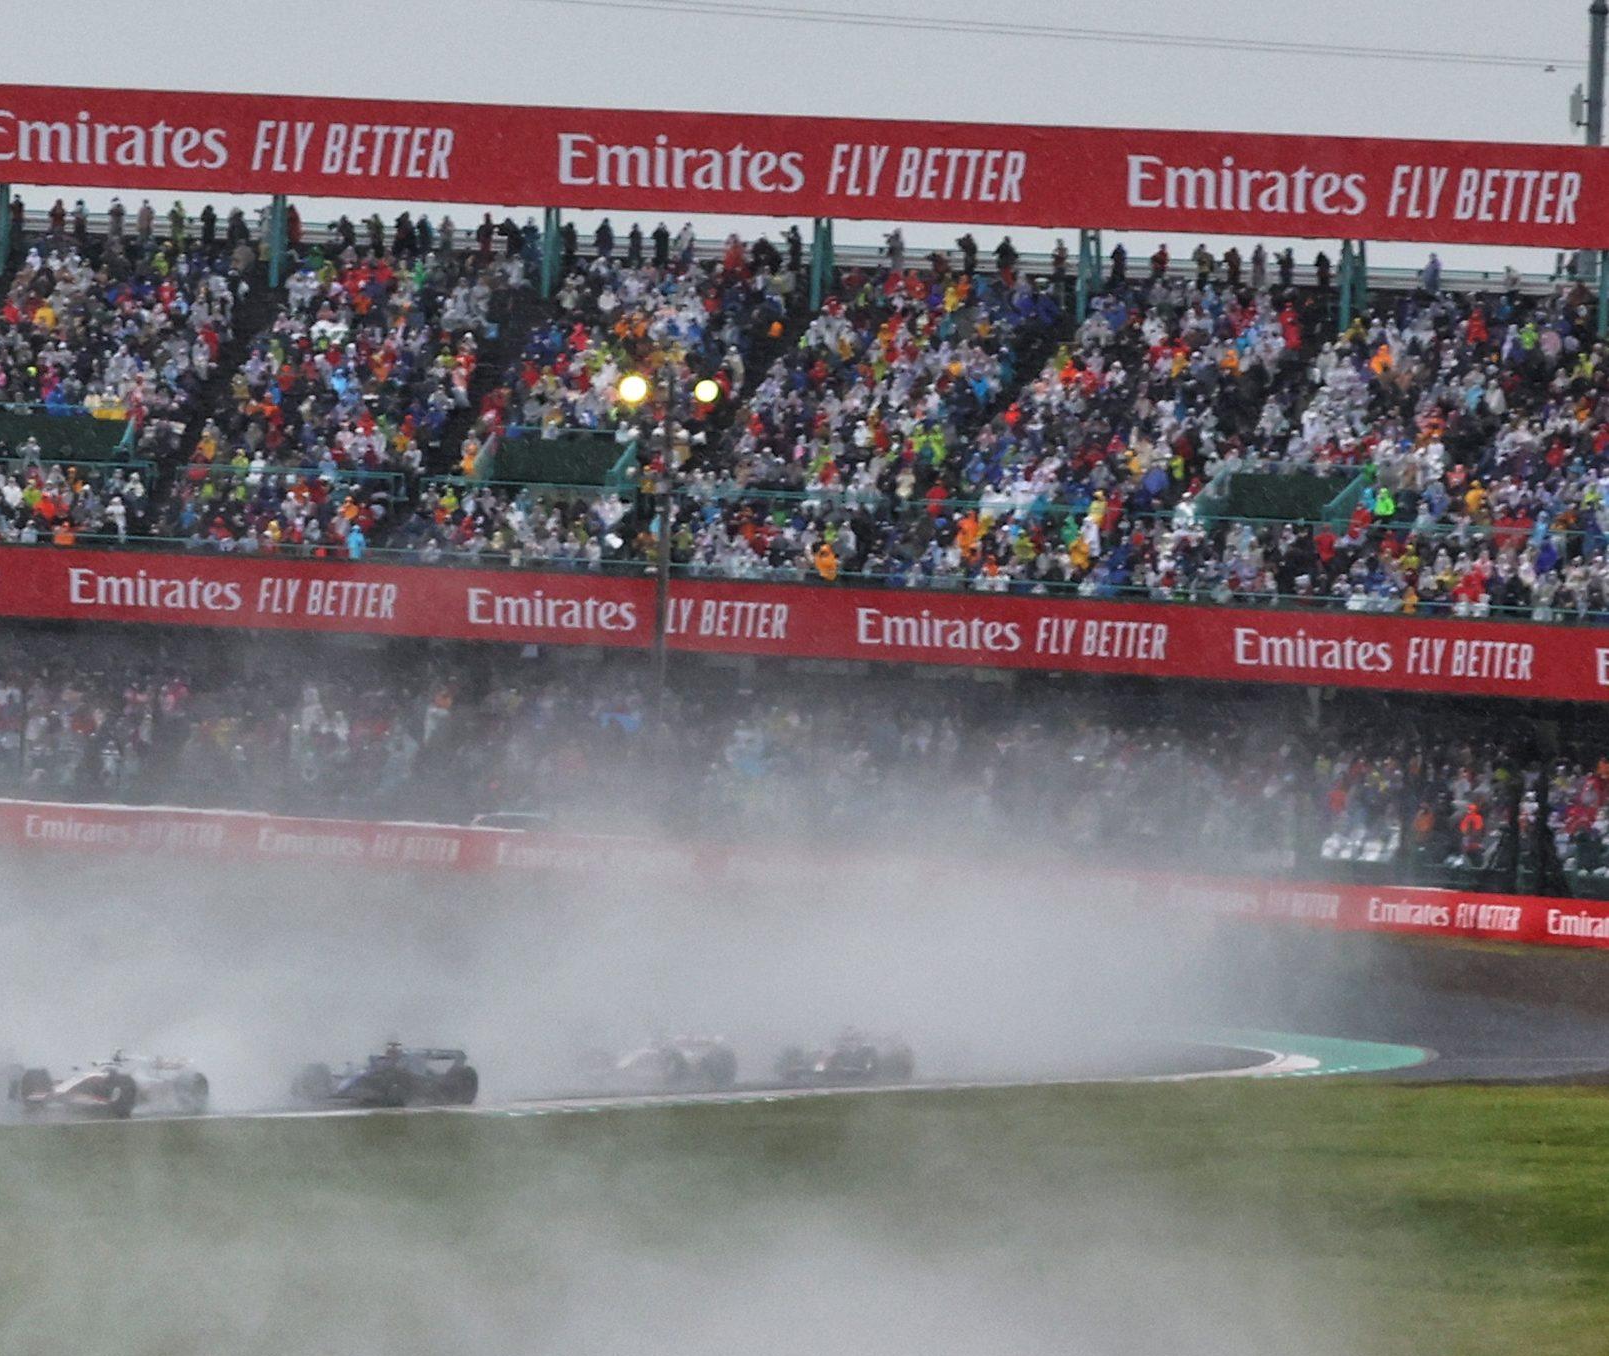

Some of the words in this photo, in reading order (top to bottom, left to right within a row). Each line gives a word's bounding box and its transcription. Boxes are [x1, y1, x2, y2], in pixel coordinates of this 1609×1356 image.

[251, 120, 315, 173] FLY
[321, 123, 454, 180] BETTER
[557, 133, 805, 193] Emirates
[826, 143, 890, 197] FLY
[895, 146, 1026, 202] BETTER
[1127, 154, 1367, 216] Emirates
[1387, 165, 1448, 219] FLY
[1453, 168, 1581, 224] BETTER
[68, 567, 242, 611] Emirates
[257, 577, 301, 615] FLY
[306, 579, 398, 619] BETTER
[467, 587, 637, 631] Emirates
[699, 599, 788, 639] BETTER
[857, 607, 1021, 652] Emirates
[1036, 617, 1078, 655] FLY
[1082, 620, 1168, 660] BETTER
[1234, 627, 1393, 672] Emirates
[1406, 637, 1448, 675] FLY
[1451, 639, 1534, 680] BETTER
[1366, 896, 1450, 927] Emirates
